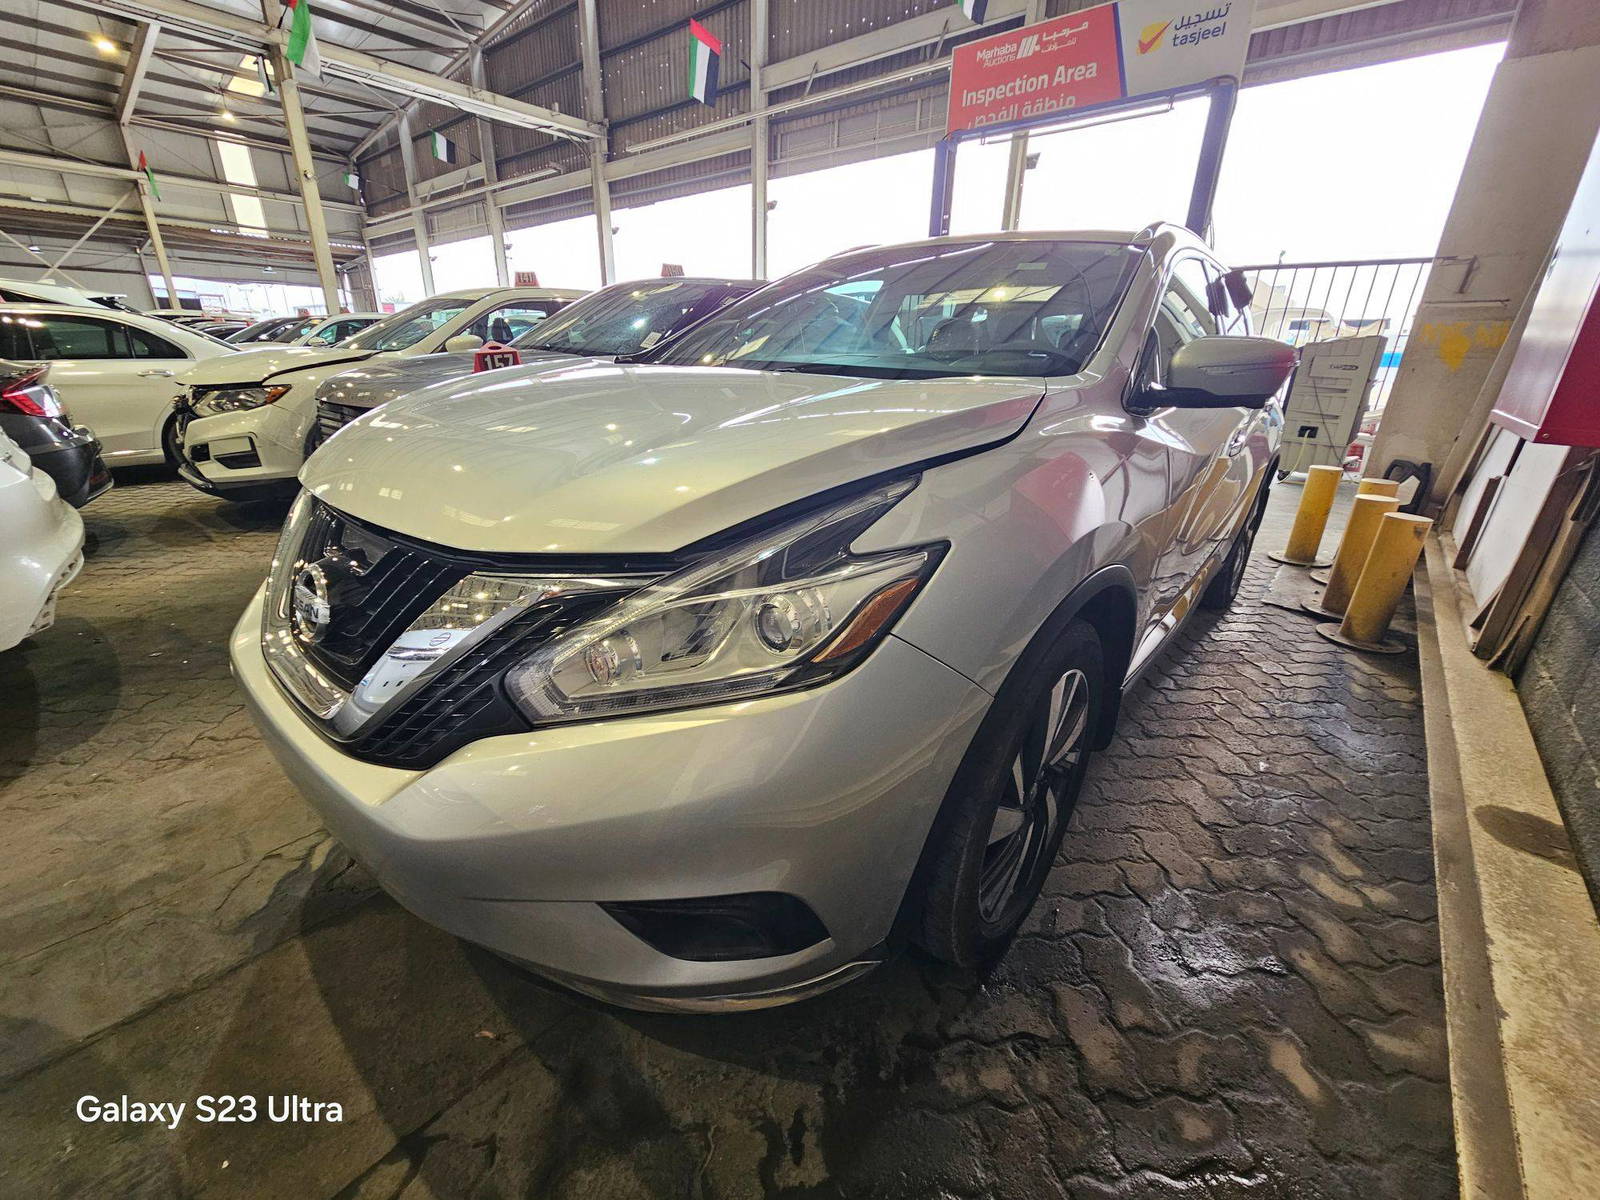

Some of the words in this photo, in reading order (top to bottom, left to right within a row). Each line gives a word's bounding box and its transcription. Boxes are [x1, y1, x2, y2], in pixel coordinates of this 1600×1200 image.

[1174, 2, 1232, 31] تسجيل
[1172, 21, 1227, 47] tasjeel
[976, 43, 1018, 62] Marhaba
[983, 53, 1016, 69] Auctions
[961, 73, 1049, 108] Inspection
[1052, 62, 1098, 87] Area
[1021, 94, 1076, 118] منطقة
[484, 353, 514, 370] 157
